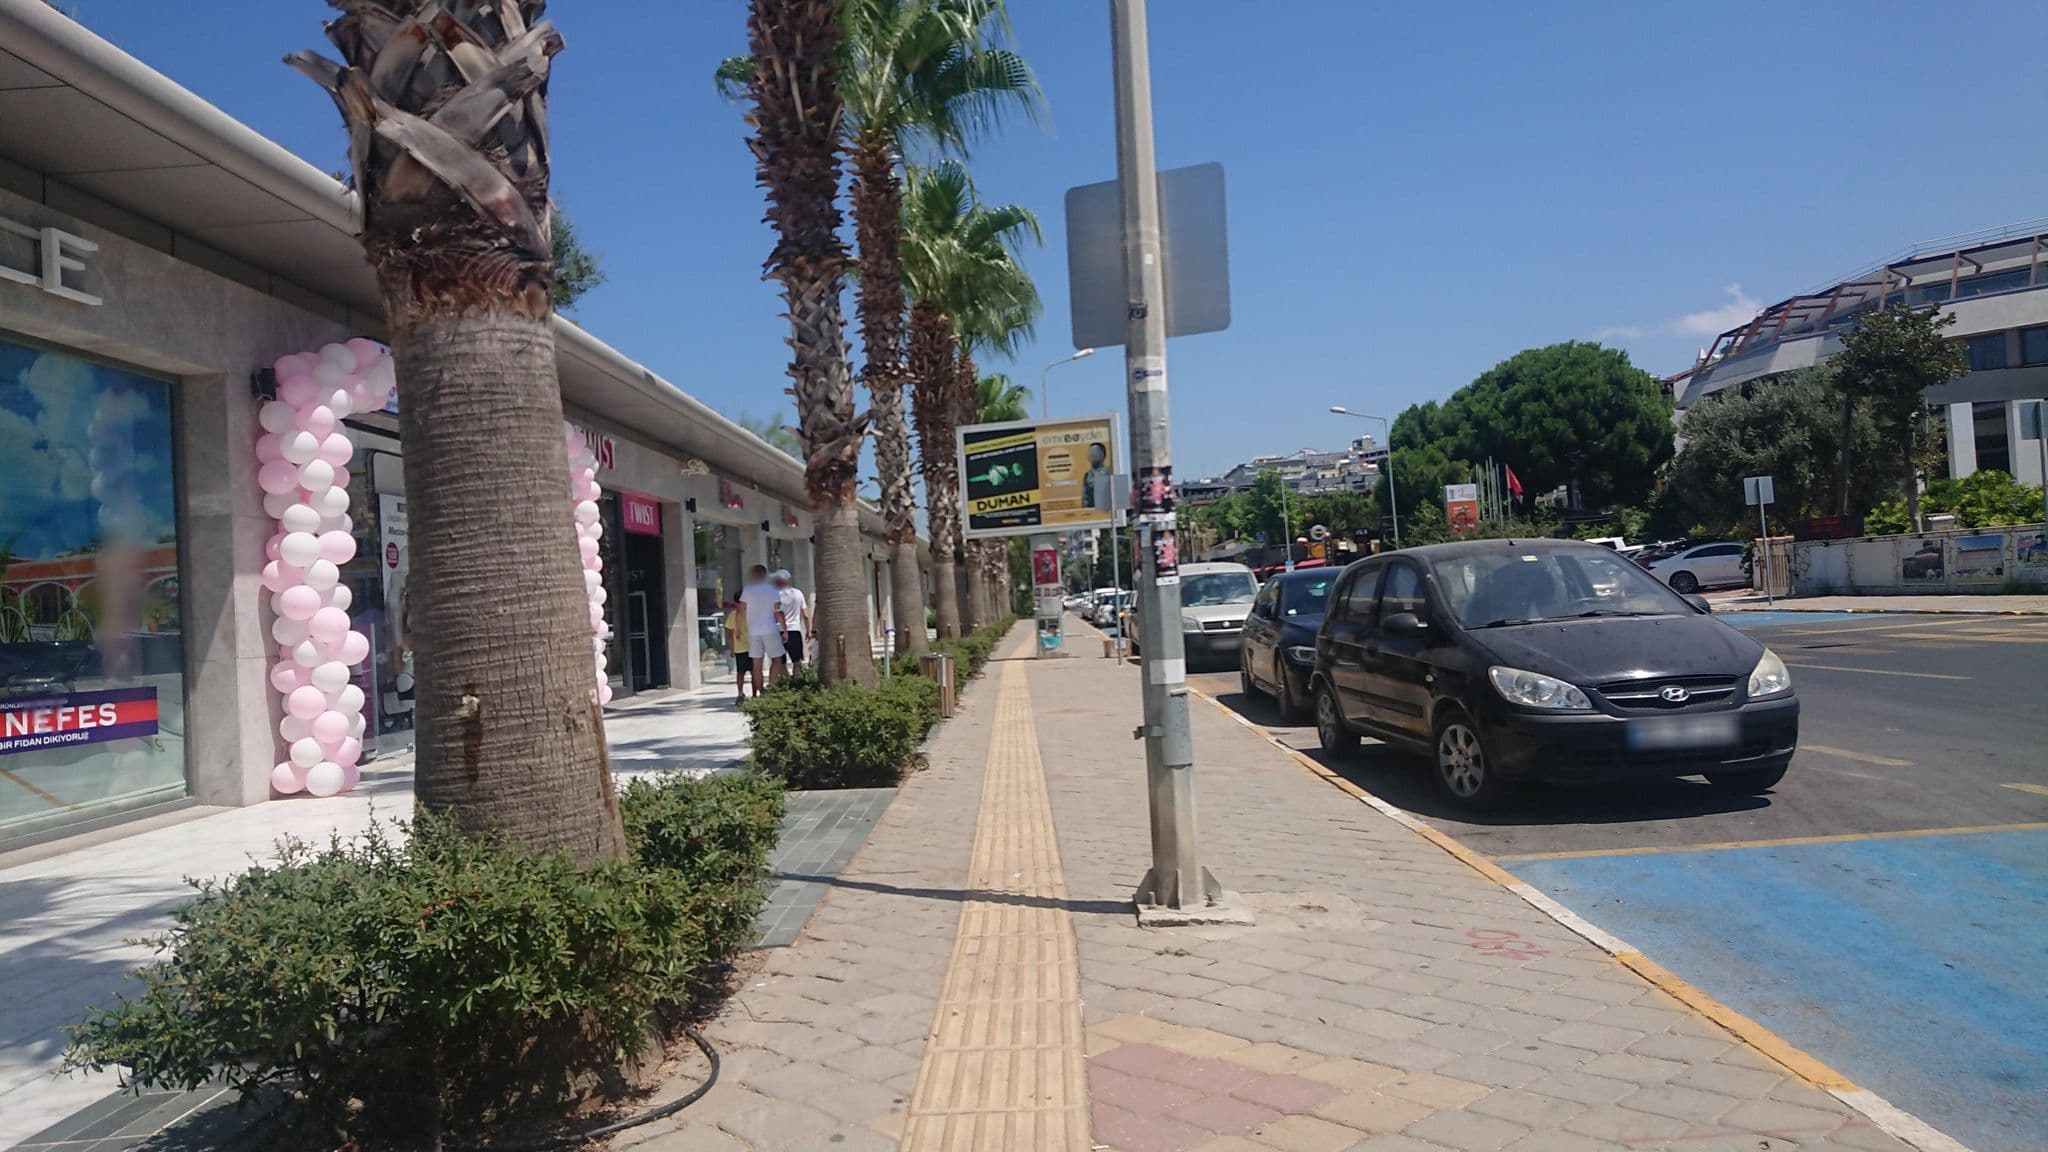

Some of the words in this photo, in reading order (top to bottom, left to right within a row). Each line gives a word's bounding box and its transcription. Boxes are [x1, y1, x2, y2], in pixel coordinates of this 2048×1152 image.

[977, 494, 1030, 511] DUMAN
[629, 502, 654, 526] TWIST
[6, 704, 117, 736] NEFES
[14, 737, 42, 747] FİDAN
[43, 732, 89, 744] DİKİYORU
